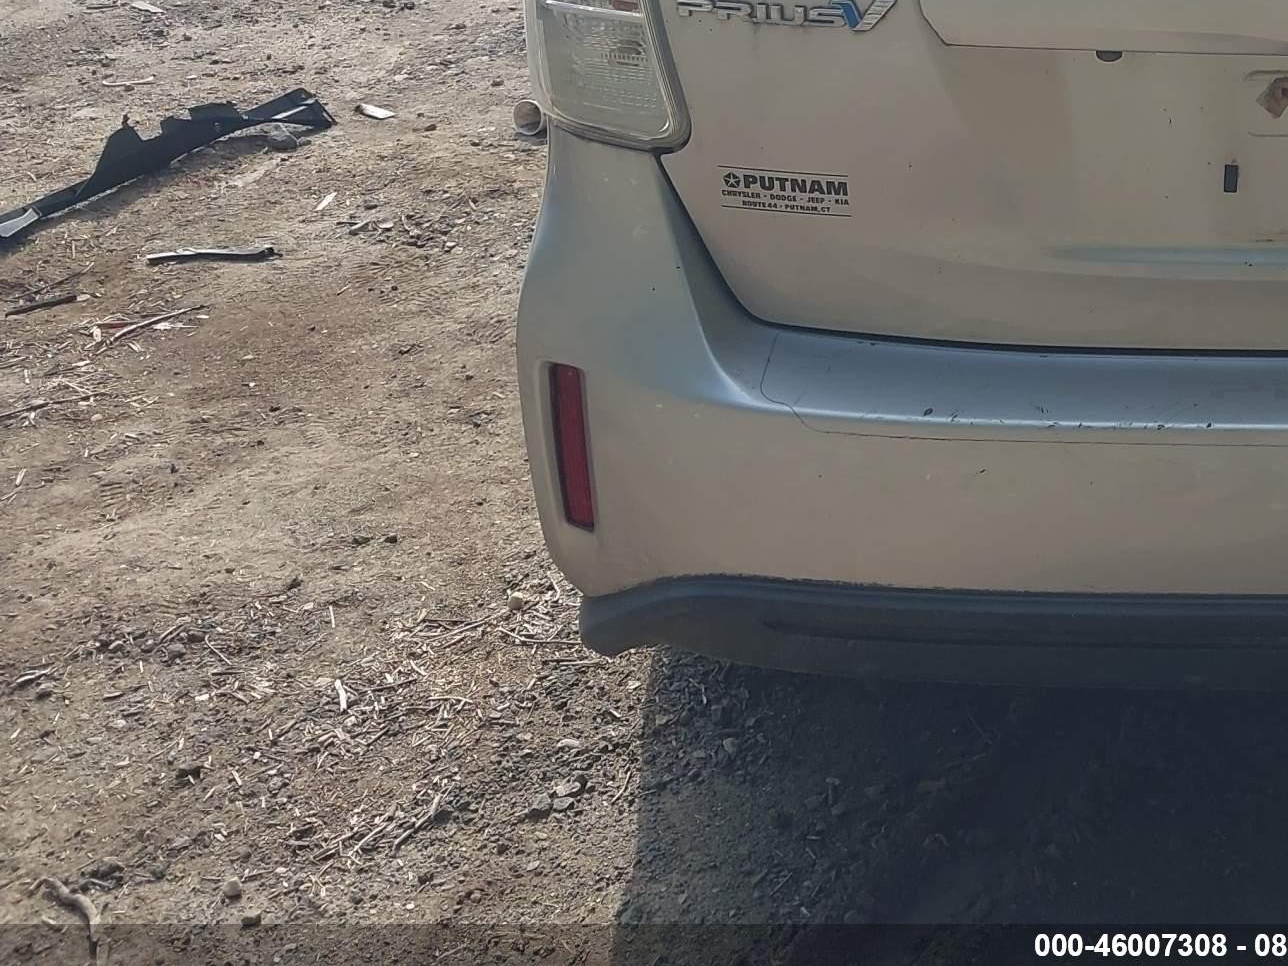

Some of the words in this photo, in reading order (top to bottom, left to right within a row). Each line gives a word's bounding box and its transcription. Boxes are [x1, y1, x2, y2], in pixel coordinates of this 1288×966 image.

[743, 174, 848, 196] PUTNAM
[722, 189, 760, 199] CHRYSLER
[769, 193, 797, 202] DODGE
[806, 196, 825, 204] JEEP
[834, 198, 849, 206] KIA
